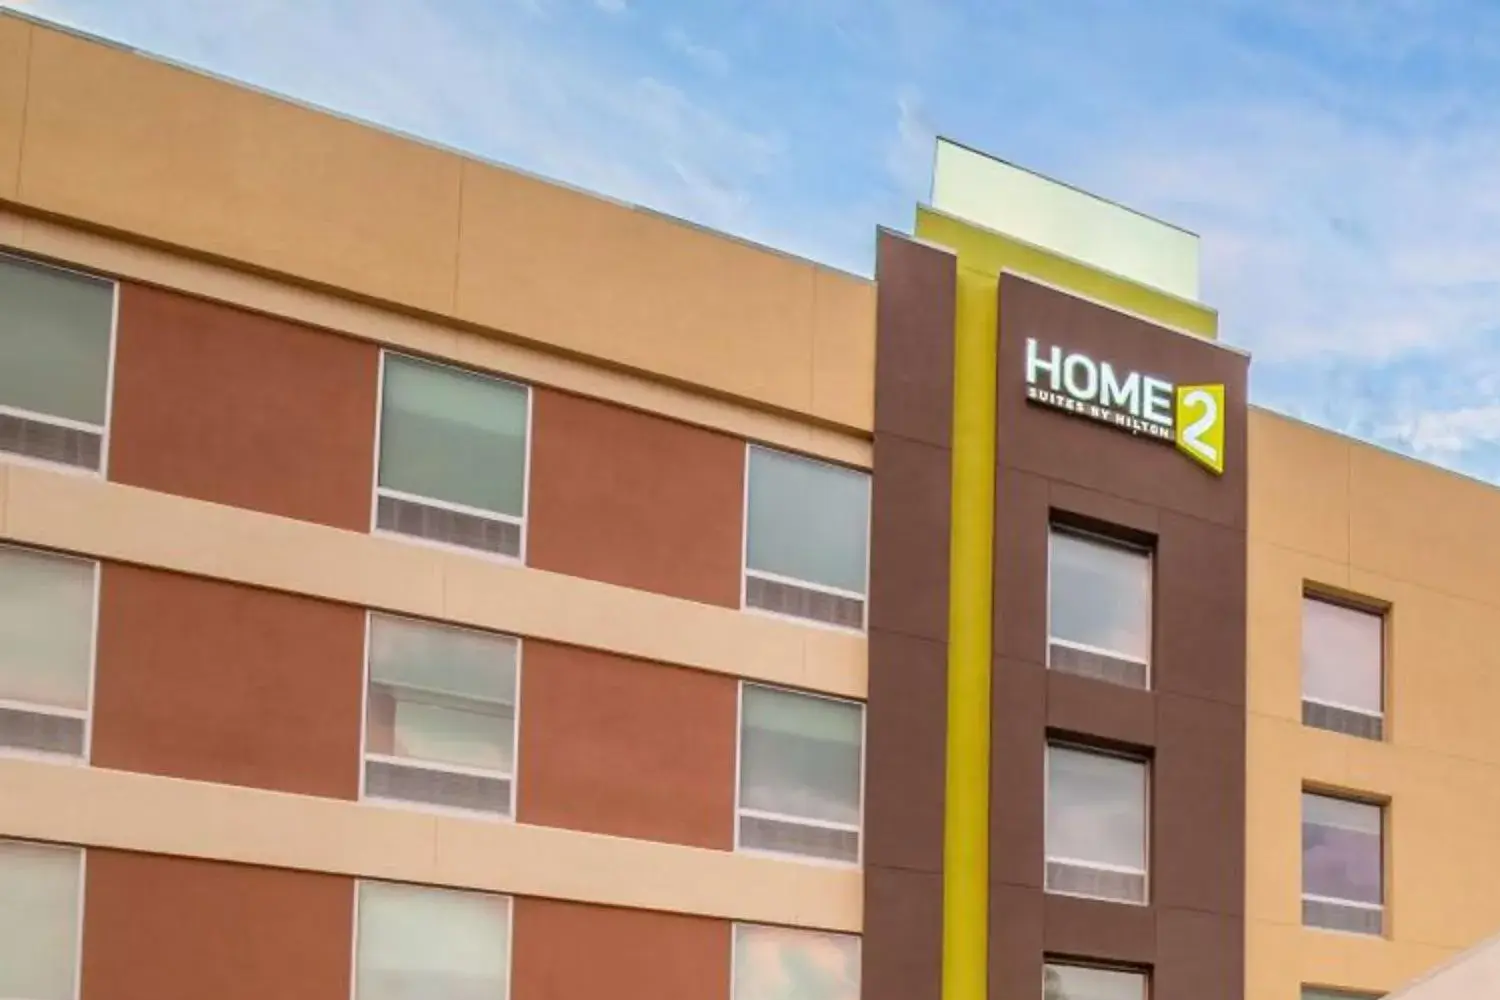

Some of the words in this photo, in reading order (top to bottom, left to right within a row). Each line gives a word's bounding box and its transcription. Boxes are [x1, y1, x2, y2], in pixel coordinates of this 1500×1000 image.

[1026, 337, 1173, 426] HOME
[1183, 389, 1218, 462] 2
[1028, 387, 1085, 413] SUITES
[1091, 405, 1110, 423] BY
[1115, 414, 1170, 439] HILTON
